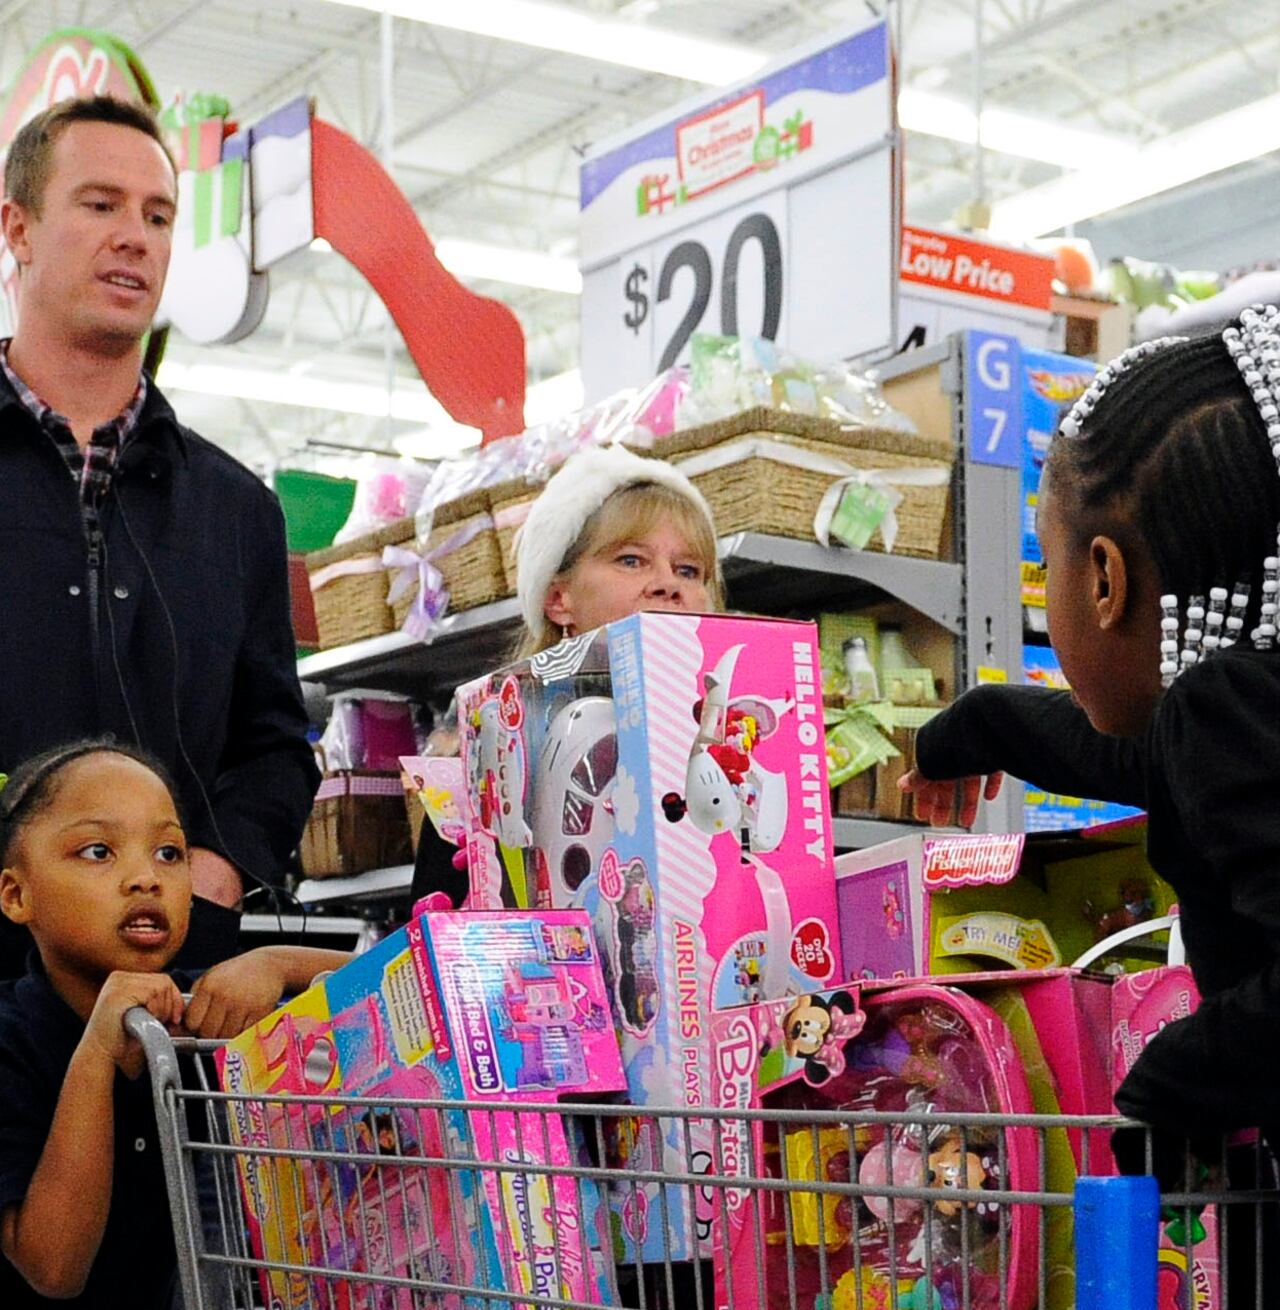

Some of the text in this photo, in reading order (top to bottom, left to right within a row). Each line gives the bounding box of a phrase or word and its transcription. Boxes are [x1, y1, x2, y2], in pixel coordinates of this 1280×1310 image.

[901, 243, 1014, 295] Low Price
[977, 339, 1010, 391] G
[983, 408, 1008, 452] 7
[793, 641, 826, 865] HELLO KITTY
[407, 928, 423, 944] 2
[812, 938, 825, 965] OVER
[803, 944, 816, 963] 20
[413, 946, 432, 997] furnished
[425, 998, 439, 1032] rooms
[467, 1010, 485, 1037] Bed
[674, 920, 704, 1126] AIRLINES PLAYST
[433, 1031, 442, 1043] in
[473, 1040, 487, 1053] &
[477, 1055, 495, 1088] Bath
[1189, 1261, 1212, 1290] TRY
